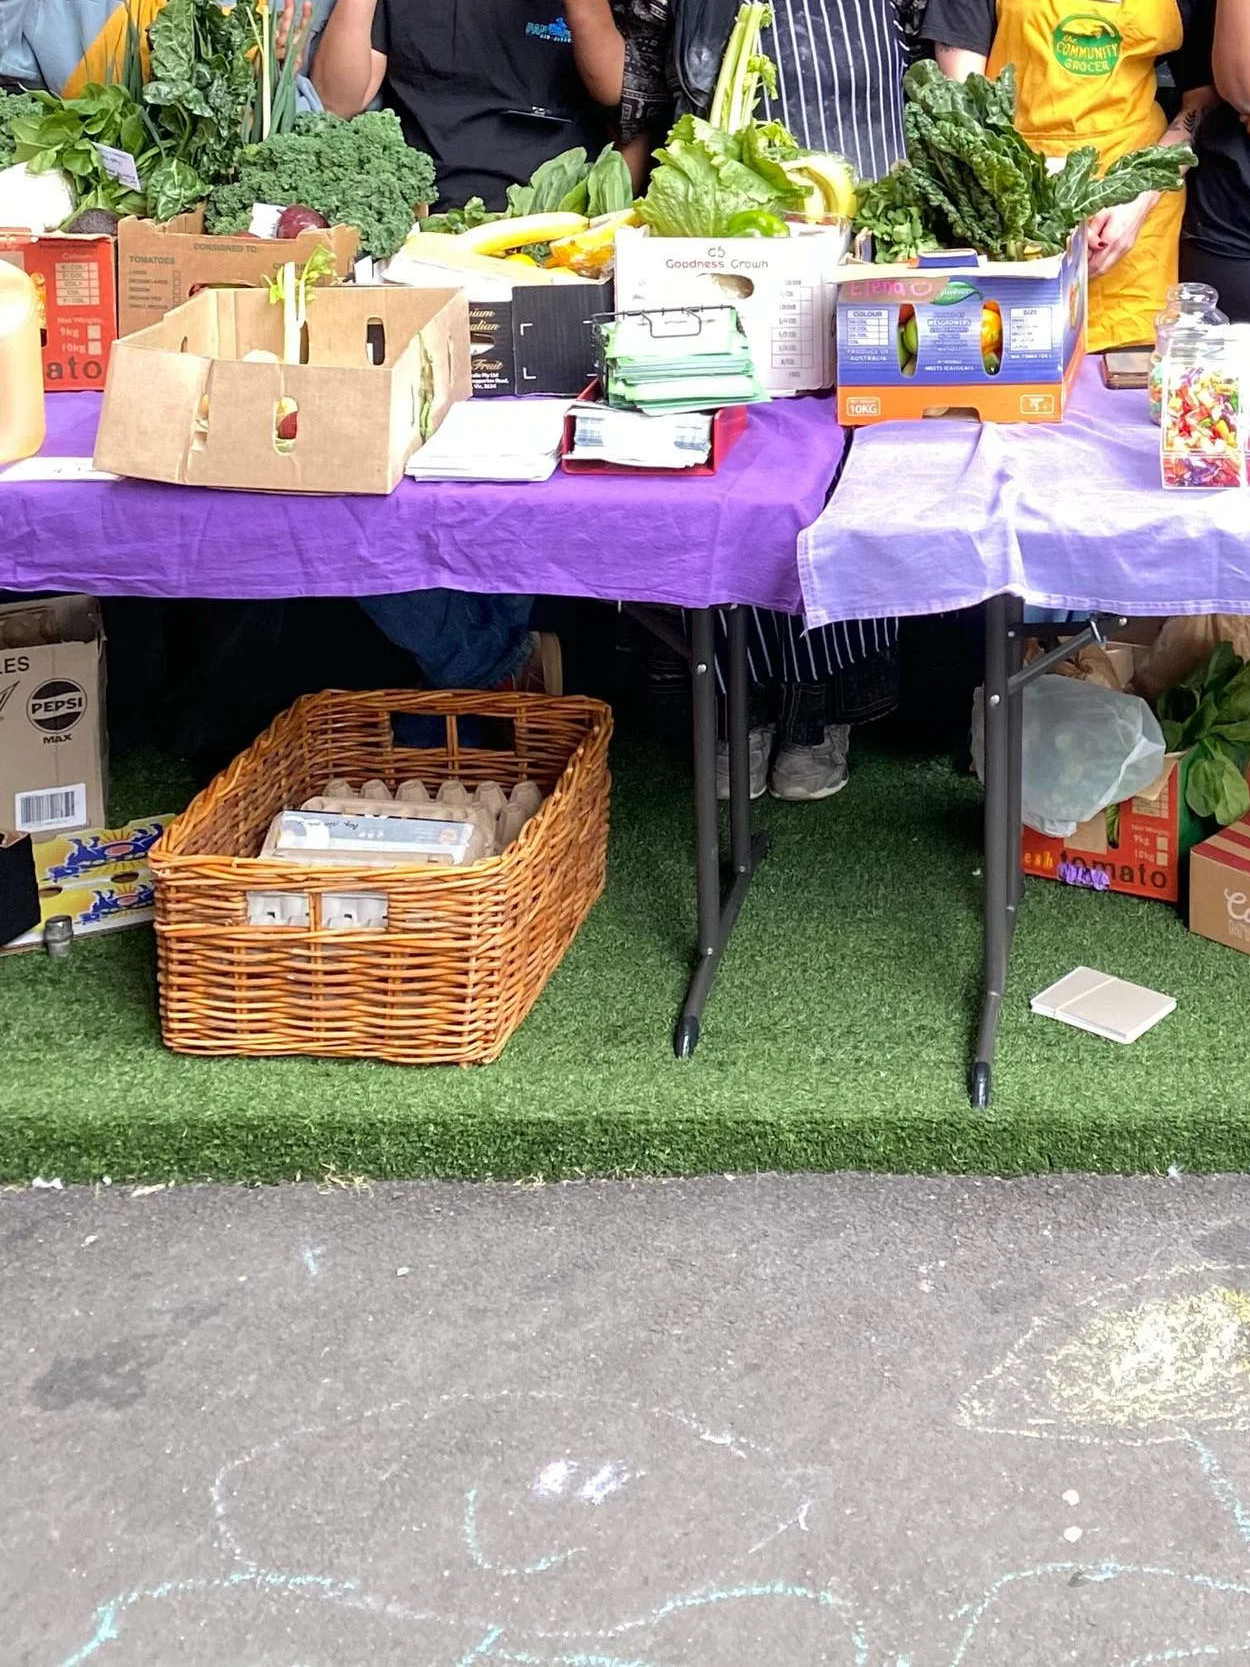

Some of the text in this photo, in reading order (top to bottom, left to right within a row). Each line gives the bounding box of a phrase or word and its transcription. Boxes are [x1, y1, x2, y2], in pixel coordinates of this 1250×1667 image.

[1056, 42, 1118, 60] COMMUNITY
[1064, 58, 1110, 72] GROCER
[193, 242, 244, 253] CONSIGNED
[128, 255, 176, 264] TOMATOES
[665, 259, 769, 269] Goodness Grown
[849, 404, 877, 414] 10KG
[0, 656, 30, 675] ES
[31, 697, 83, 715] PEPSI
[43, 734, 72, 744] MAX
